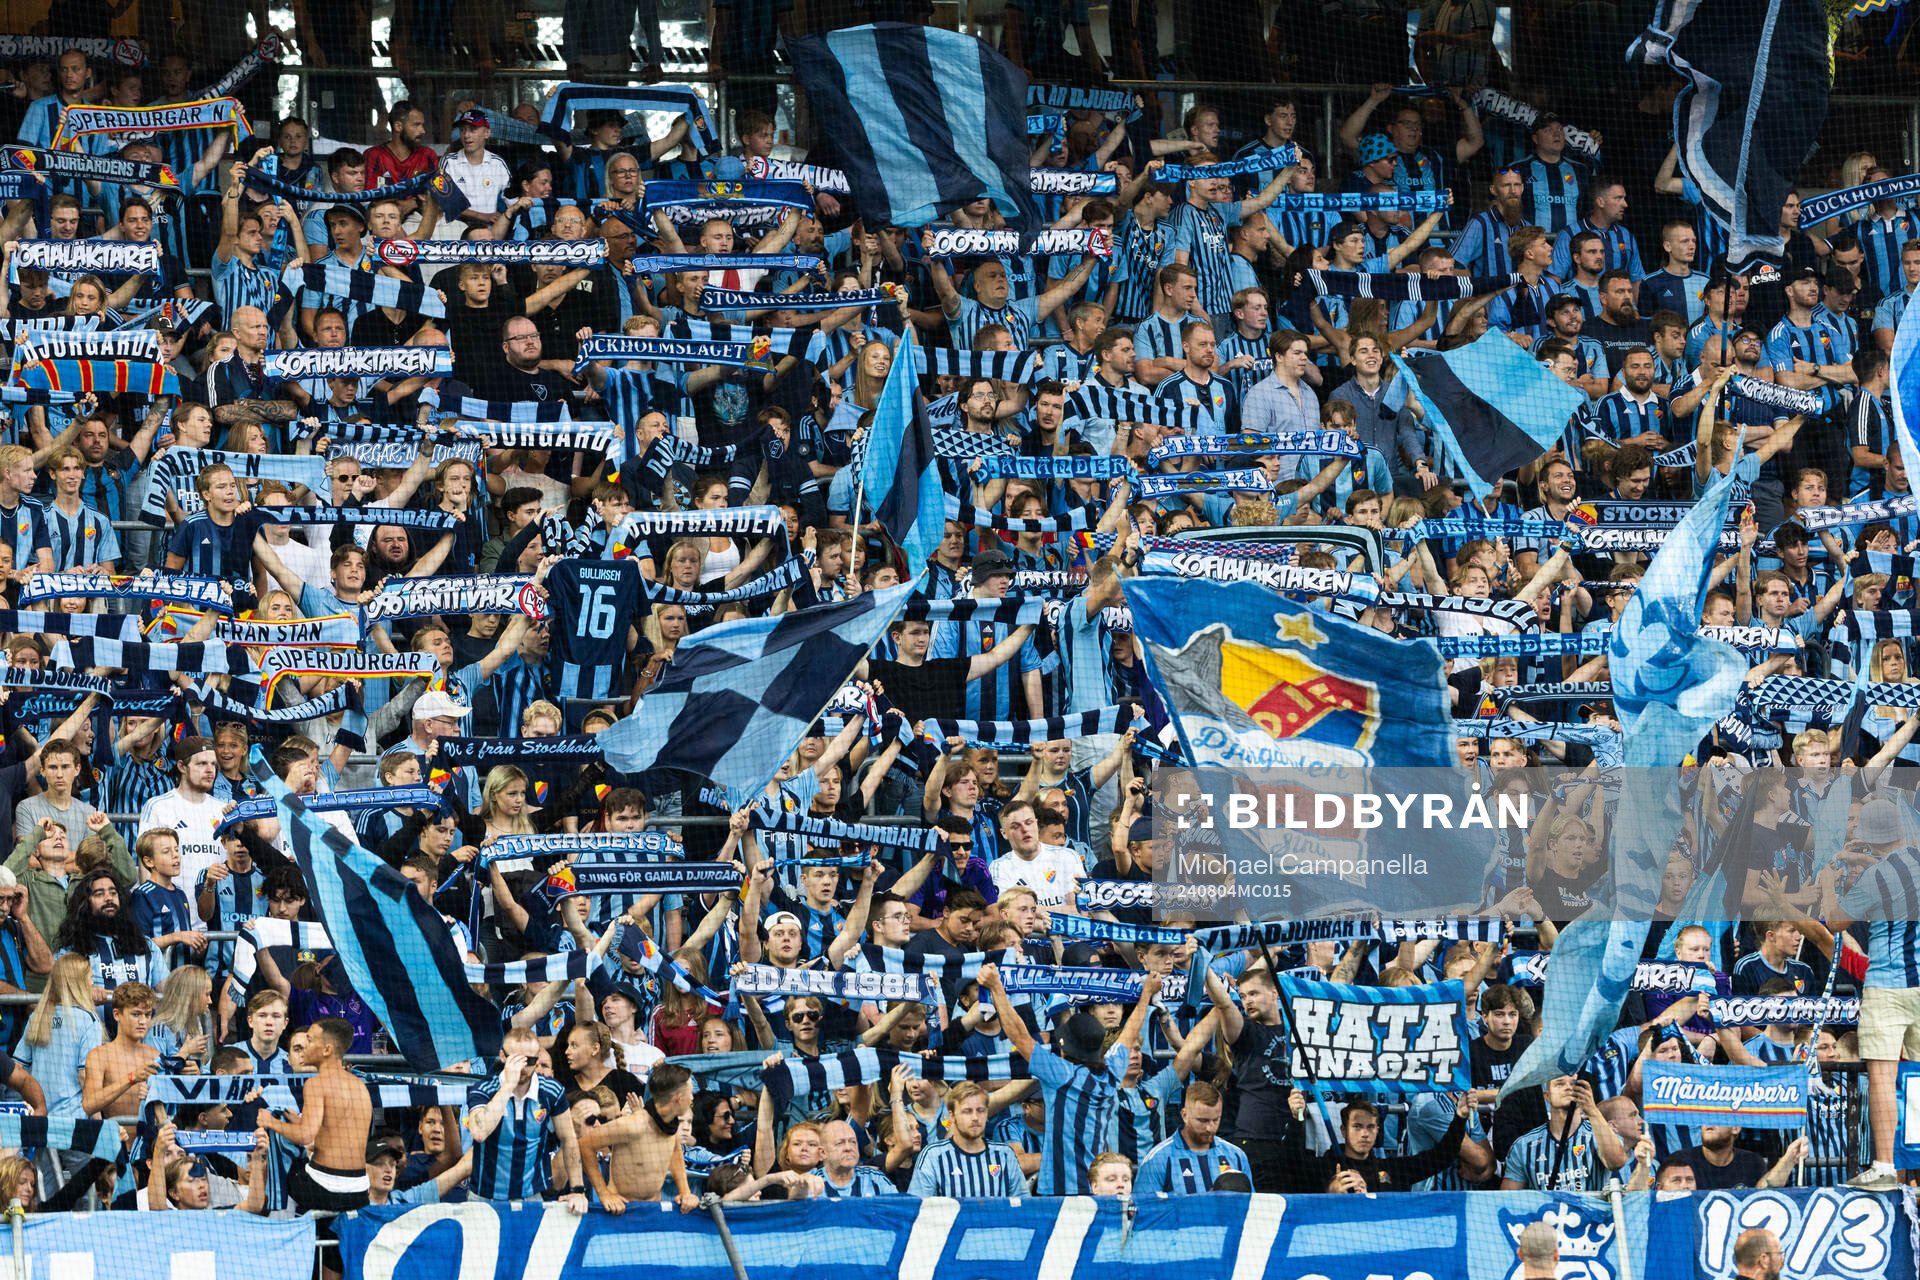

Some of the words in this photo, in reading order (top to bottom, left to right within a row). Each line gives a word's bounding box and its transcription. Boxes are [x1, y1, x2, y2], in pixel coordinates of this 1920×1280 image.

[138, 164, 151, 178] IF
[275, 348, 436, 377] SOFIALÄKTAREN
[1150, 433, 1222, 460] STIL
[1275, 430, 1360, 455] KAOS
[466, 588, 516, 612] VAR
[576, 585, 617, 639] 16
[277, 620, 325, 642] STAN
[478, 741, 515, 759] från
[579, 874, 618, 884] SJUNG
[620, 869, 642, 882] FÖR
[645, 871, 684, 882] GAMLA
[841, 971, 922, 1000] 1981
[1292, 998, 1458, 1050] HATA
[1652, 1075, 1800, 1111] Måndagsbarn
